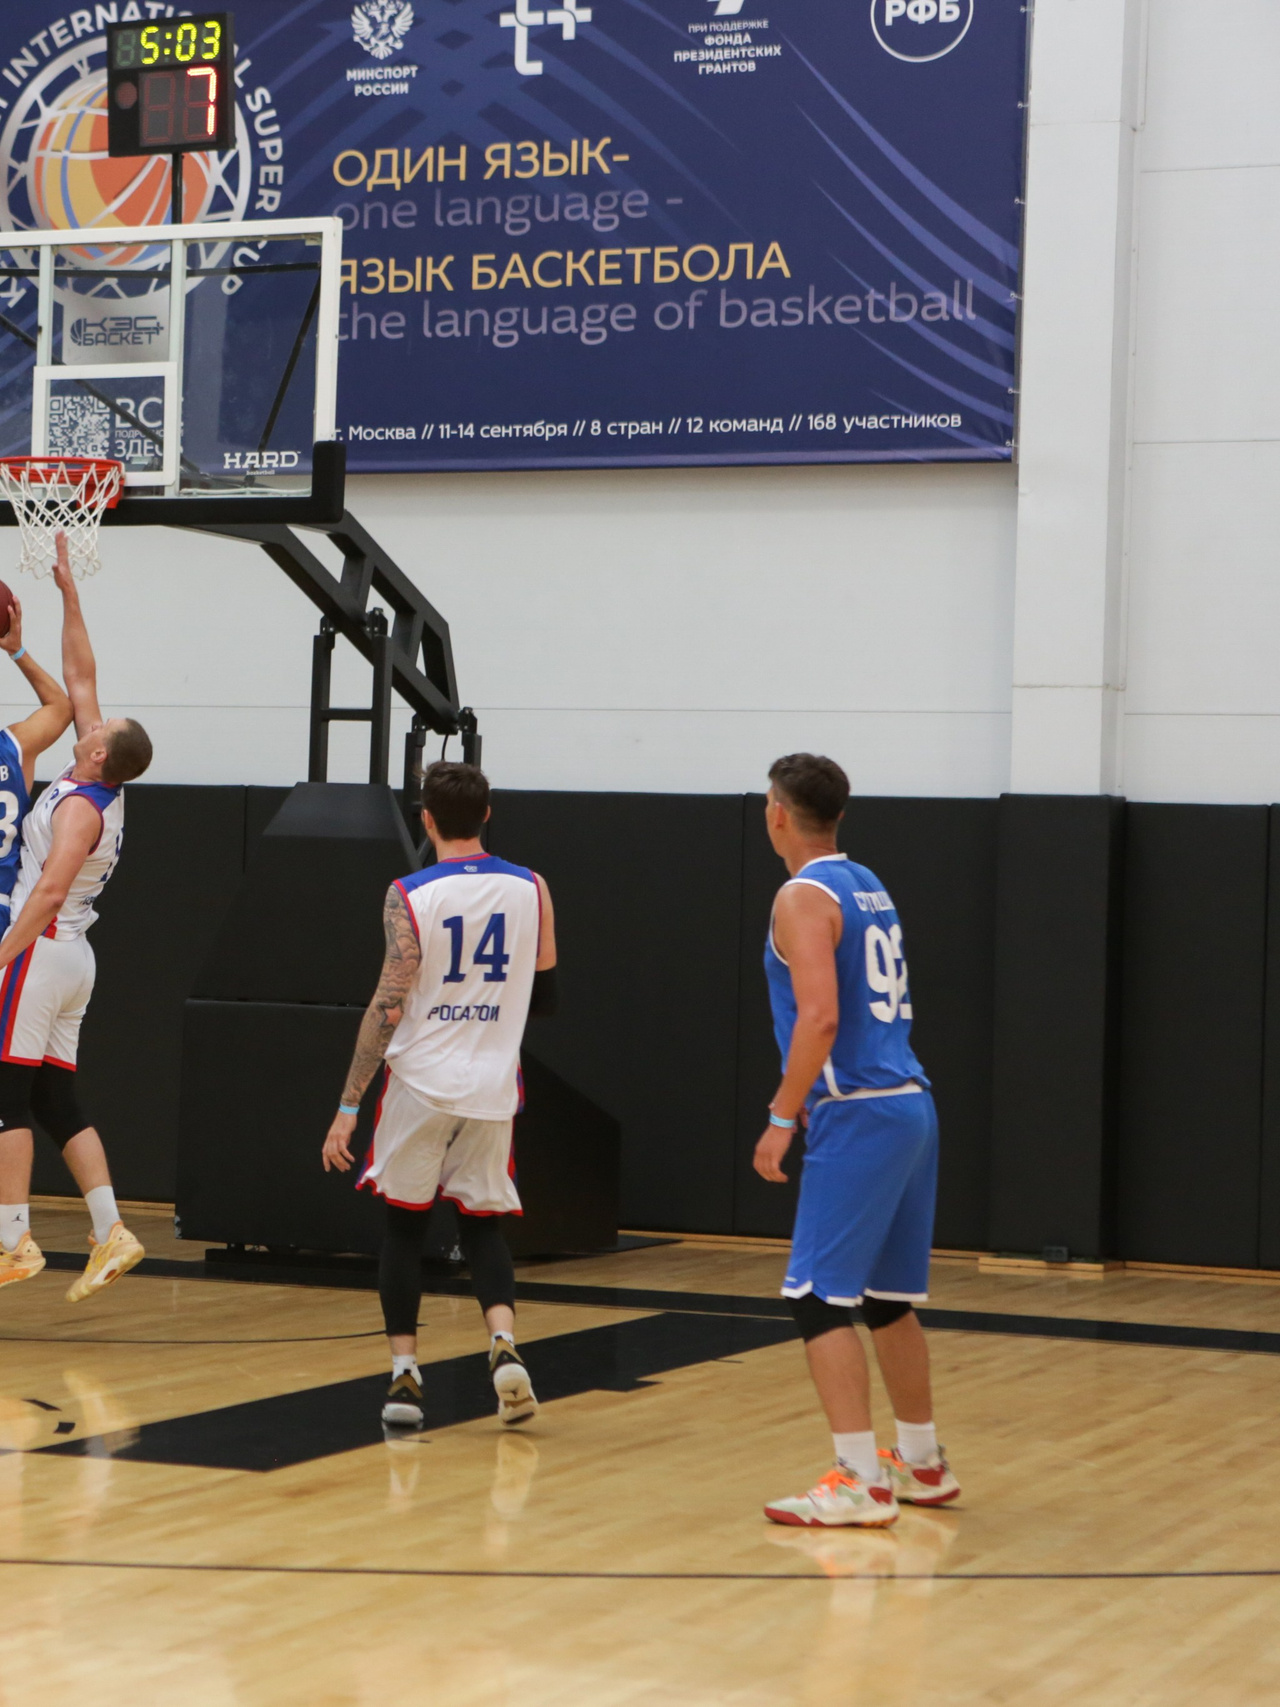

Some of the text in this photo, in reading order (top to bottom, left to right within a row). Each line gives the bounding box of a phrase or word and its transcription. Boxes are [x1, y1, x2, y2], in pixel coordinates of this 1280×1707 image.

[688, 18, 769, 33] ПРИ ПОДДЕРЖКЕ
[885, 0, 960, 26] РФБ
[140, 20, 221, 65] 5:03
[674, 44, 782, 62] ПРЕЗИДЕНТСКИХ
[704, 32, 752, 46] ФОНДА
[346, 65, 418, 81] МИНСПОРТ
[698, 60, 756, 75] ГРАНТОВ
[187, 67, 217, 136] 7
[354, 82, 409, 96] РОССИИ
[245, 86, 284, 213] SUPER
[333, 145, 467, 192] ОДИН
[333, 200, 418, 231] one
[434, 189, 649, 236] language
[221, 239, 268, 295] UP
[340, 241, 792, 294] ЯЗЫК БАСКЕТБОЛА
[338, 278, 976, 348] the language of basketball
[83, 332, 156, 346] БАСКЕТ
[349, 425, 416, 441] Москва
[438, 423, 475, 438] 11-14
[480, 420, 568, 441] сентября
[590, 420, 601, 436] 8
[607, 420, 663, 439] стран
[686, 417, 703, 433] 12
[709, 416, 783, 433] команд
[807, 413, 837, 430] 168
[843, 413, 962, 433] участников
[223, 451, 299, 469] HARD
[442, 912, 510, 985] 14
